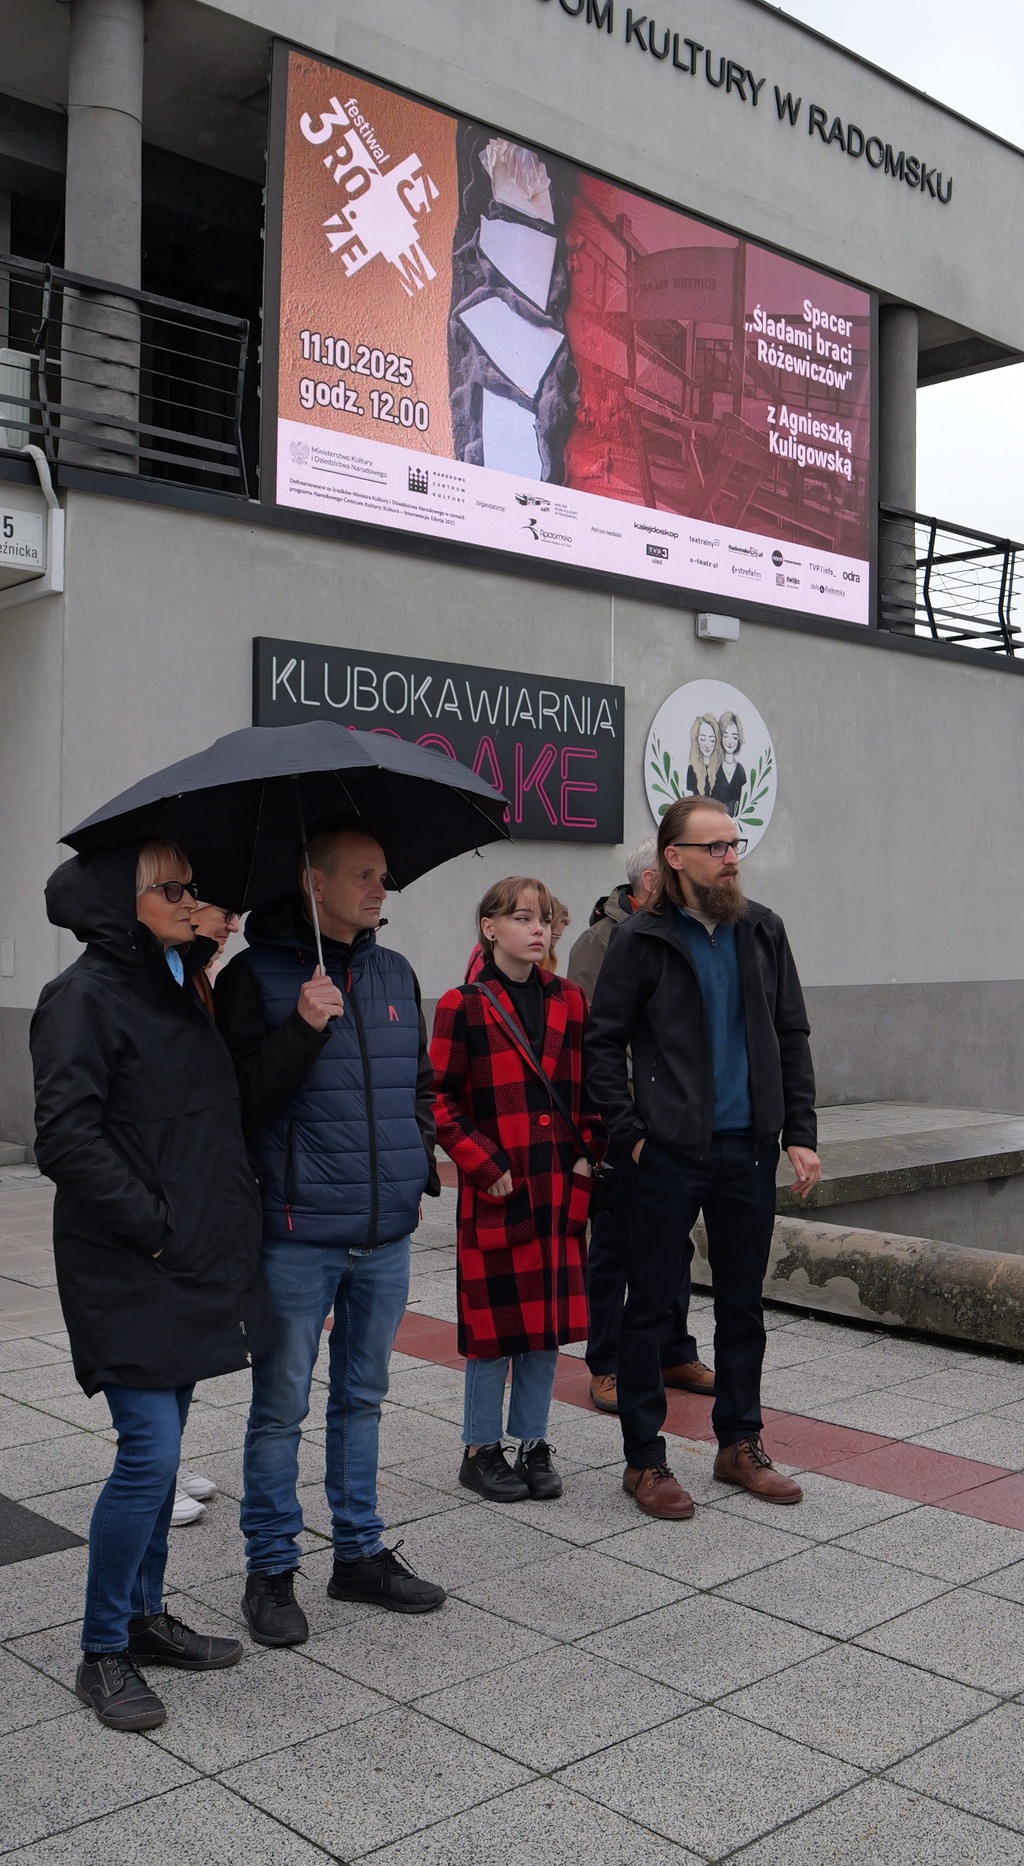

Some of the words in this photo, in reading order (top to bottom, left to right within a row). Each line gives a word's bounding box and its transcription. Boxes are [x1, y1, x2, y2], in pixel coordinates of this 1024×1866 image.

[536, 0, 613, 33] OM
[625, 7, 766, 106] KULTURY
[774, 85, 801, 126] W
[809, 104, 953, 204] RADOMSKU
[344, 98, 390, 164] festiwal
[802, 299, 852, 337] Spacer
[300, 329, 414, 387] 11.10.2025
[816, 332, 852, 366] braci
[300, 377, 365, 416] godz.
[369, 390, 430, 432] 12.00
[767, 405, 776, 424] z
[779, 404, 852, 453] Agnieszką
[311, 447, 350, 461] Ministerstwo
[351, 456, 373, 466] Kultury
[314, 455, 350, 469] Dziedzictwa
[351, 464, 388, 478] Narodowego
[769, 430, 852, 481] Kuligowską
[433, 472, 465, 482] NARODOWE
[433, 482, 465, 492] CENTRUM
[433, 493, 465, 503] KULTURY
[3, 515, 14, 538] 5
[634, 522, 678, 539] kalejdoskop
[689, 536, 714, 548] teatralny
[843, 571, 860, 583] odra
[272, 656, 616, 738] KLUBOKAWIARNIA
